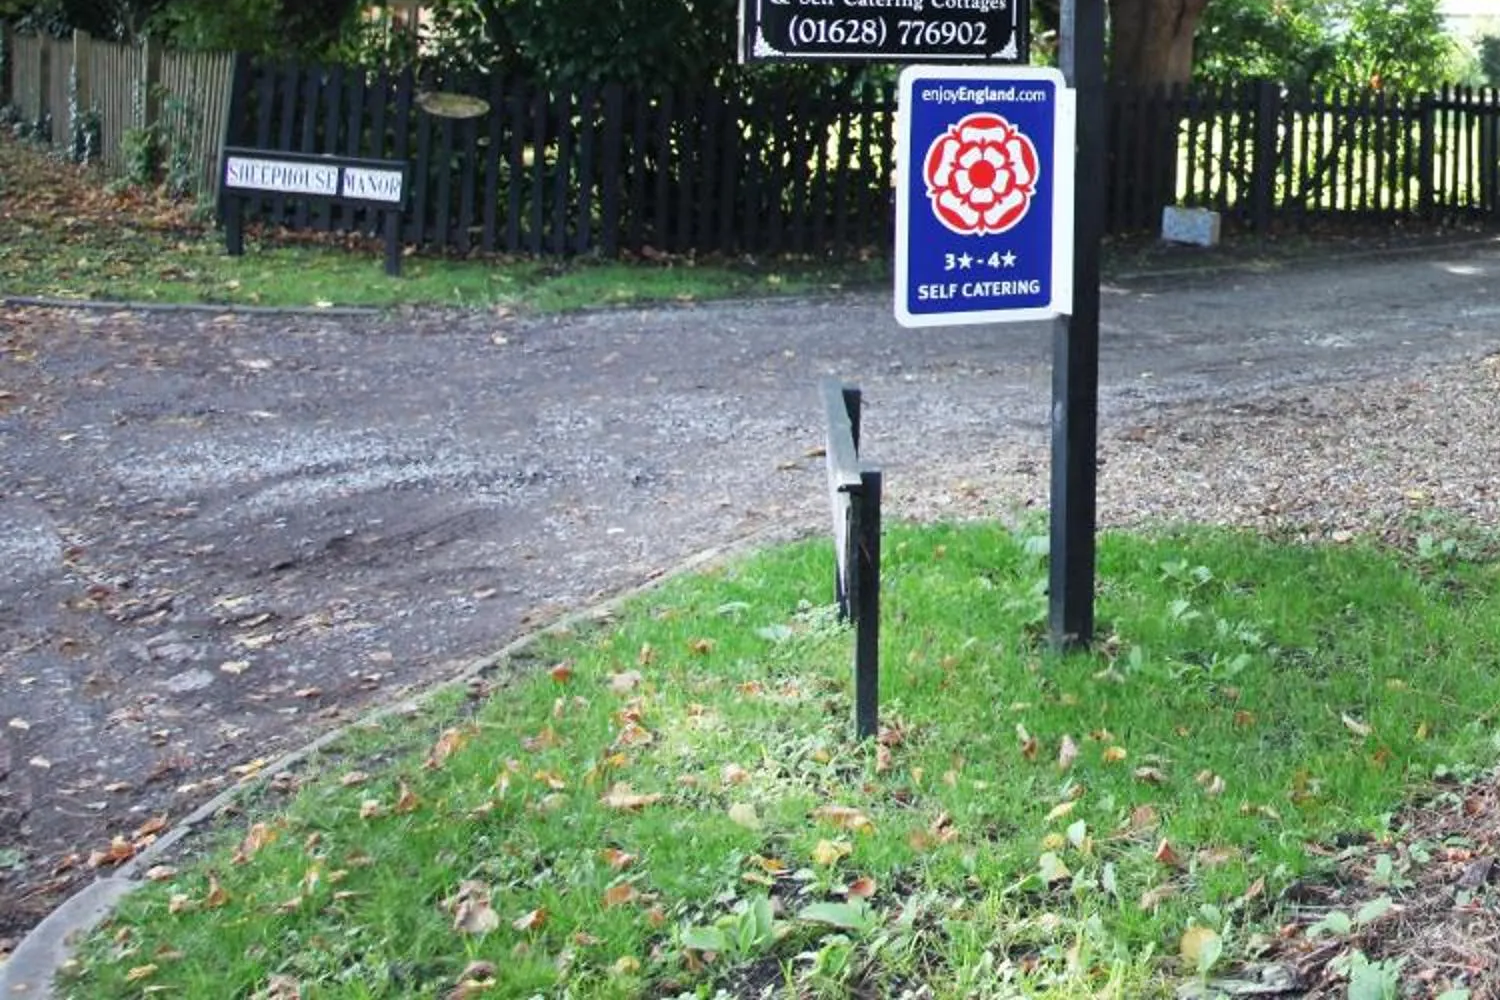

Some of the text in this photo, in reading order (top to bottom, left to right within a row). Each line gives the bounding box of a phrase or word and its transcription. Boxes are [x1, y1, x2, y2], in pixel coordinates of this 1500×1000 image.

[788, 15, 987, 47] (01628) 776902
[922, 86, 1046, 105] enjoyEngland.com
[229, 162, 399, 195] SHEEPHOUSE MANOR
[918, 280, 1041, 300] SELF CATERING
